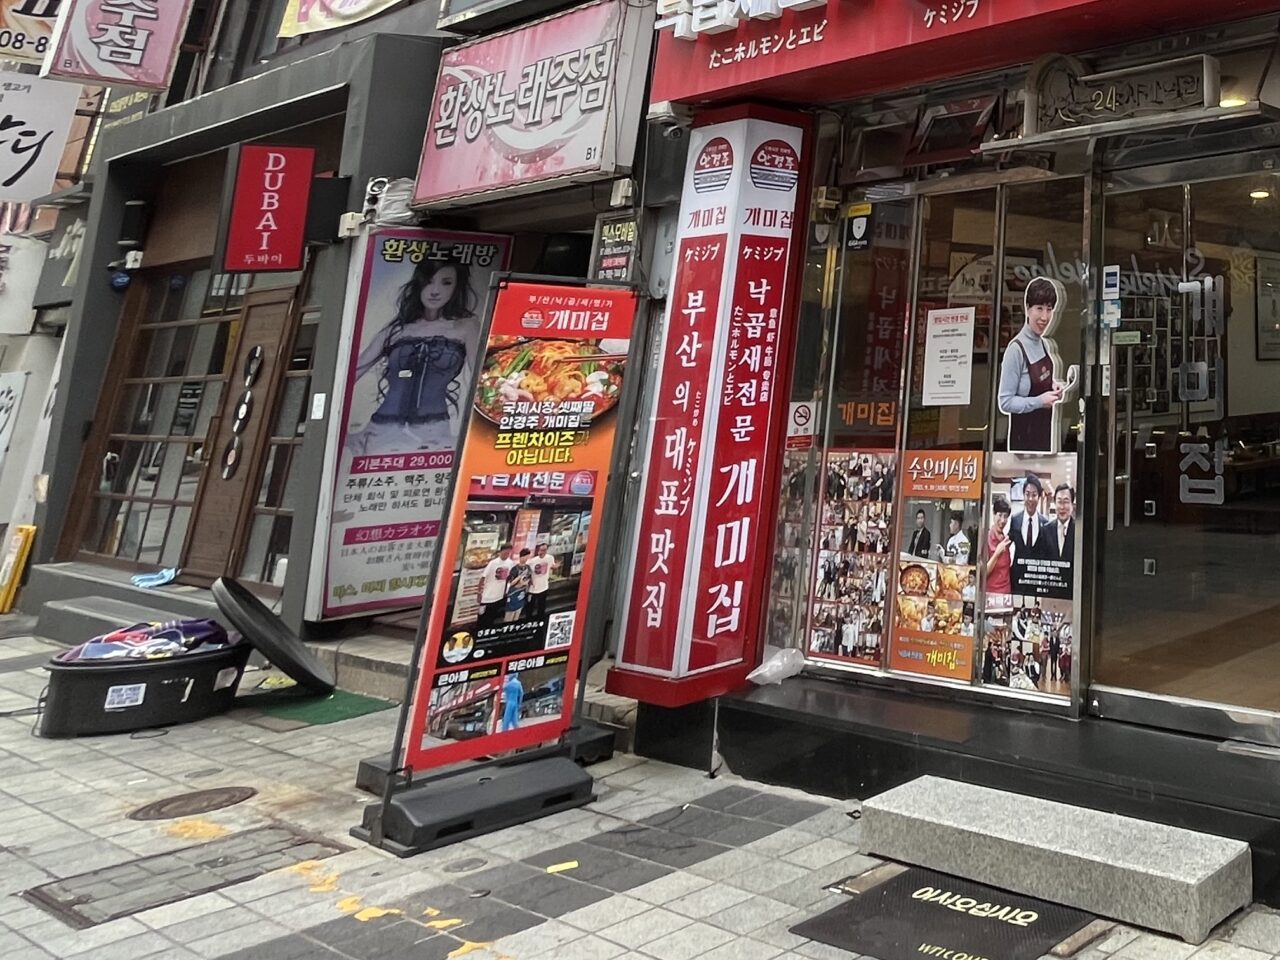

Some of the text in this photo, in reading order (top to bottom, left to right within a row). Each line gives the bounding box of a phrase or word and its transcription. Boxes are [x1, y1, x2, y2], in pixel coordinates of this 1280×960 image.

[709, 19, 829, 70] たこホルモンとエビ
[433, 40, 616, 152] 환상노래주점
[584, 145, 597, 161] B1
[255, 151, 287, 251] DUBAI
[687, 206, 728, 230] 개미집
[743, 207, 795, 230] 개미집
[242, 251, 284, 266] 두바이
[382, 238, 499, 266] 환상노래방
[684, 243, 721, 263] ケミジプ
[742, 245, 785, 262] ケミジプ
[545, 309, 610, 331] 개미집
[499, 415, 539, 430] 안경주
[837, 402, 897, 426] 개미집
[409, 454, 453, 468] 29,000
[506, 448, 574, 466] 아닙니다.
[706, 278, 772, 639] 낙곱새전문 개미집
[926, 649, 958, 671] 개미집
